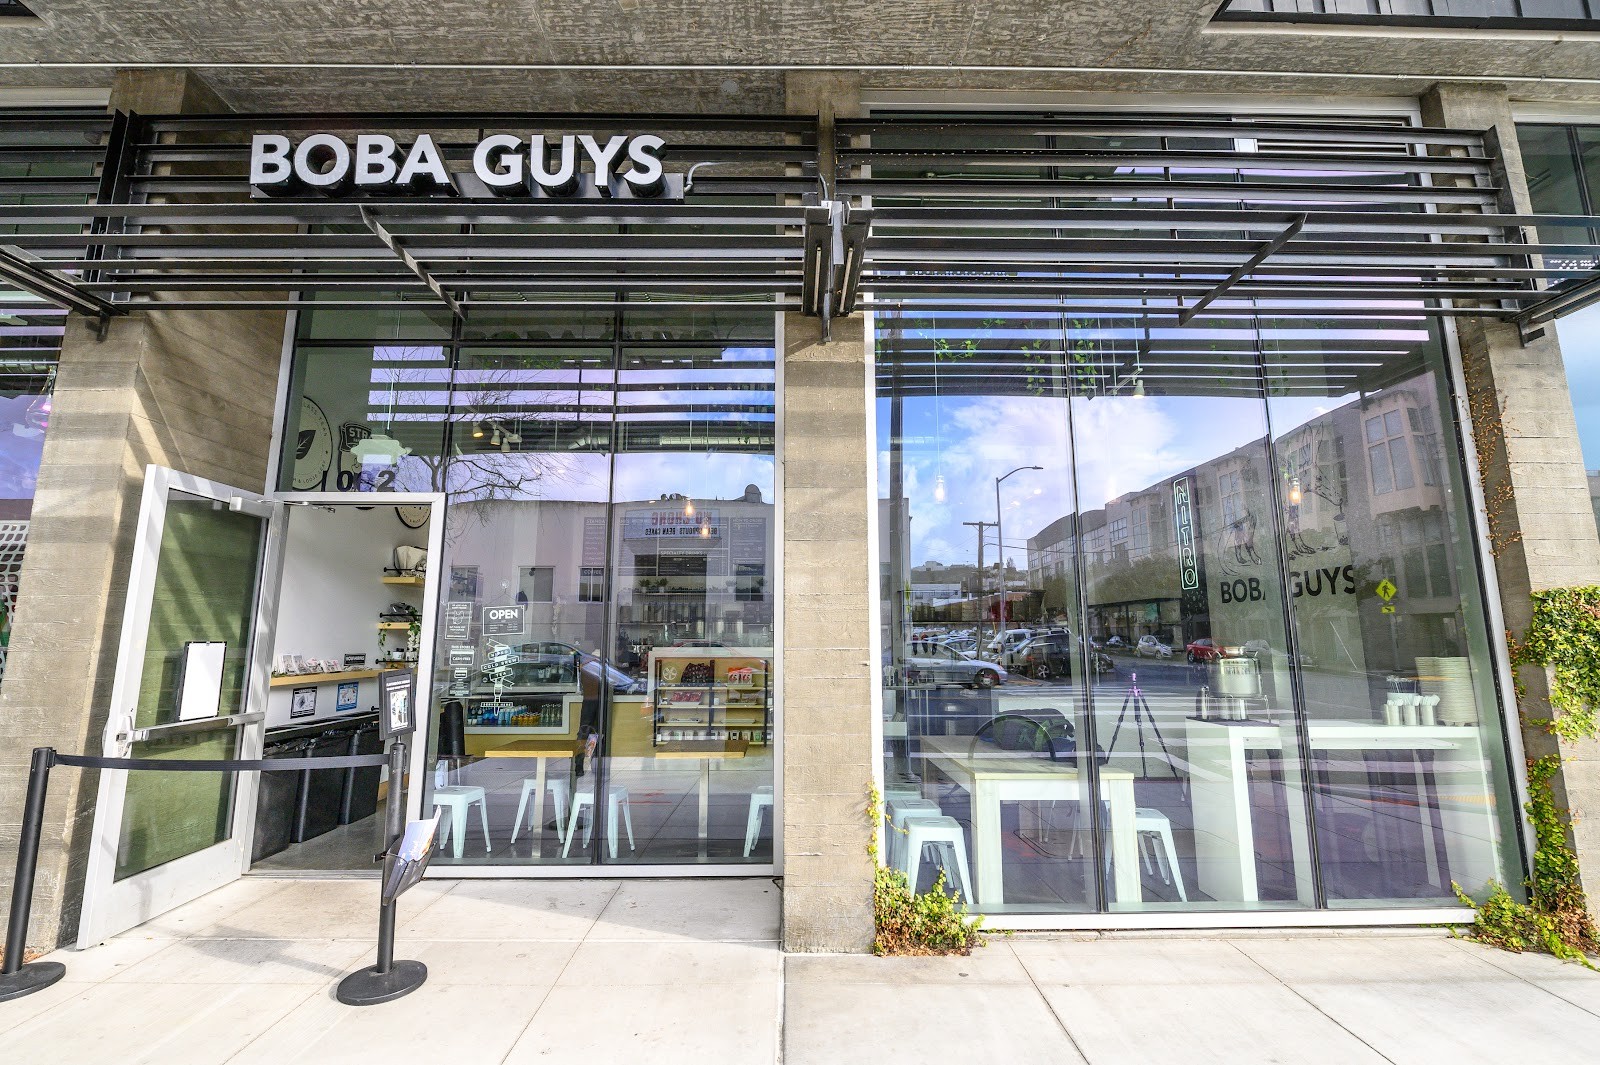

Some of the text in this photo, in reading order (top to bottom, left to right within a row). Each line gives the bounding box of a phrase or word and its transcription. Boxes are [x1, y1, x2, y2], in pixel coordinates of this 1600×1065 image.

[249, 134, 667, 189] BOBA GUYS
[349, 427, 372, 440] STR
[1175, 484, 1196, 586] NITRO
[1220, 564, 1356, 604] BOB GUYS
[489, 608, 518, 620] OPEN
[483, 658, 517, 670] COLD BREW
